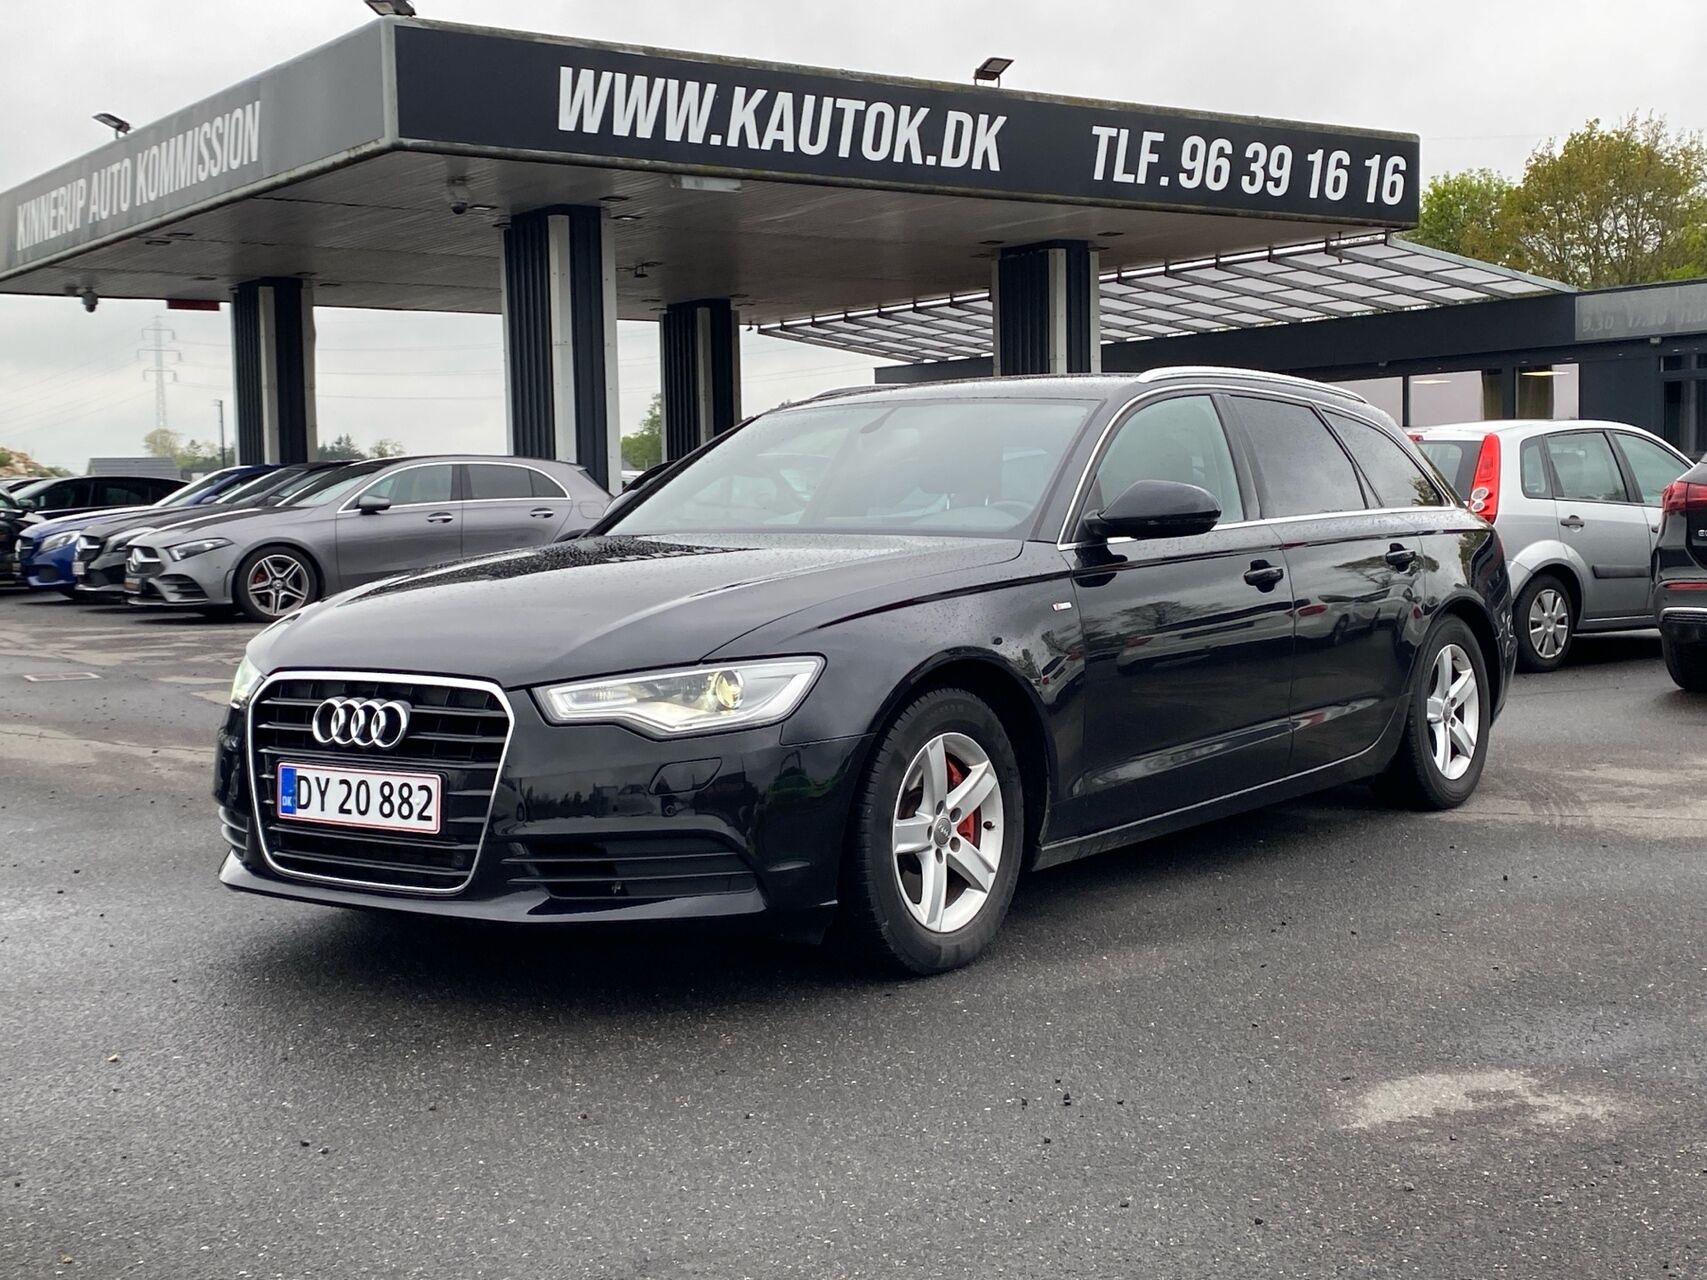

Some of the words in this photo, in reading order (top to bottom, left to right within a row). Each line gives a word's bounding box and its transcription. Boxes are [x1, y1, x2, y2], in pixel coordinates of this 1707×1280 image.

[558, 66, 1007, 171] WWW.KAUTOK.DK
[17, 178, 86, 251] KINNERUP
[88, 158, 132, 224] AUTO
[135, 101, 261, 206] KOMMISSION
[1092, 126, 1170, 187] TLF.
[1178, 136, 1233, 191] 96
[1240, 142, 1293, 197] 39
[1307, 149, 1350, 201] 16
[1364, 154, 1407, 206] 16
[296, 775, 330, 812] DY
[338, 779, 371, 816] 20
[379, 781, 433, 822] 882
